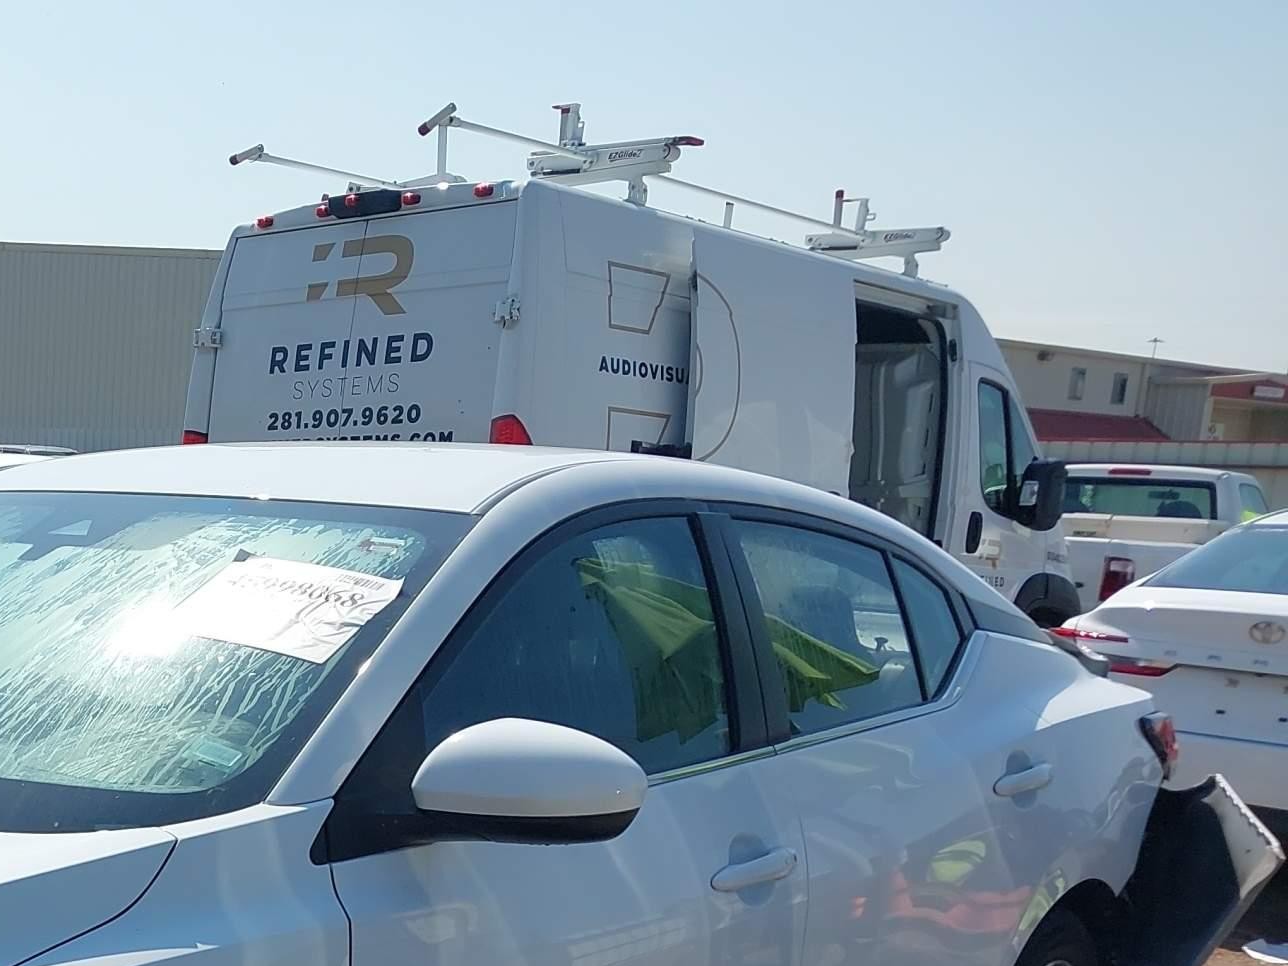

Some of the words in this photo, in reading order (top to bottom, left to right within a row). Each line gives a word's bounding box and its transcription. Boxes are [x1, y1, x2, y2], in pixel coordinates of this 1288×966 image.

[269, 332, 434, 374] REFINED
[292, 372, 401, 400] SYSTEMS
[267, 403, 422, 431] 281.907.9620
